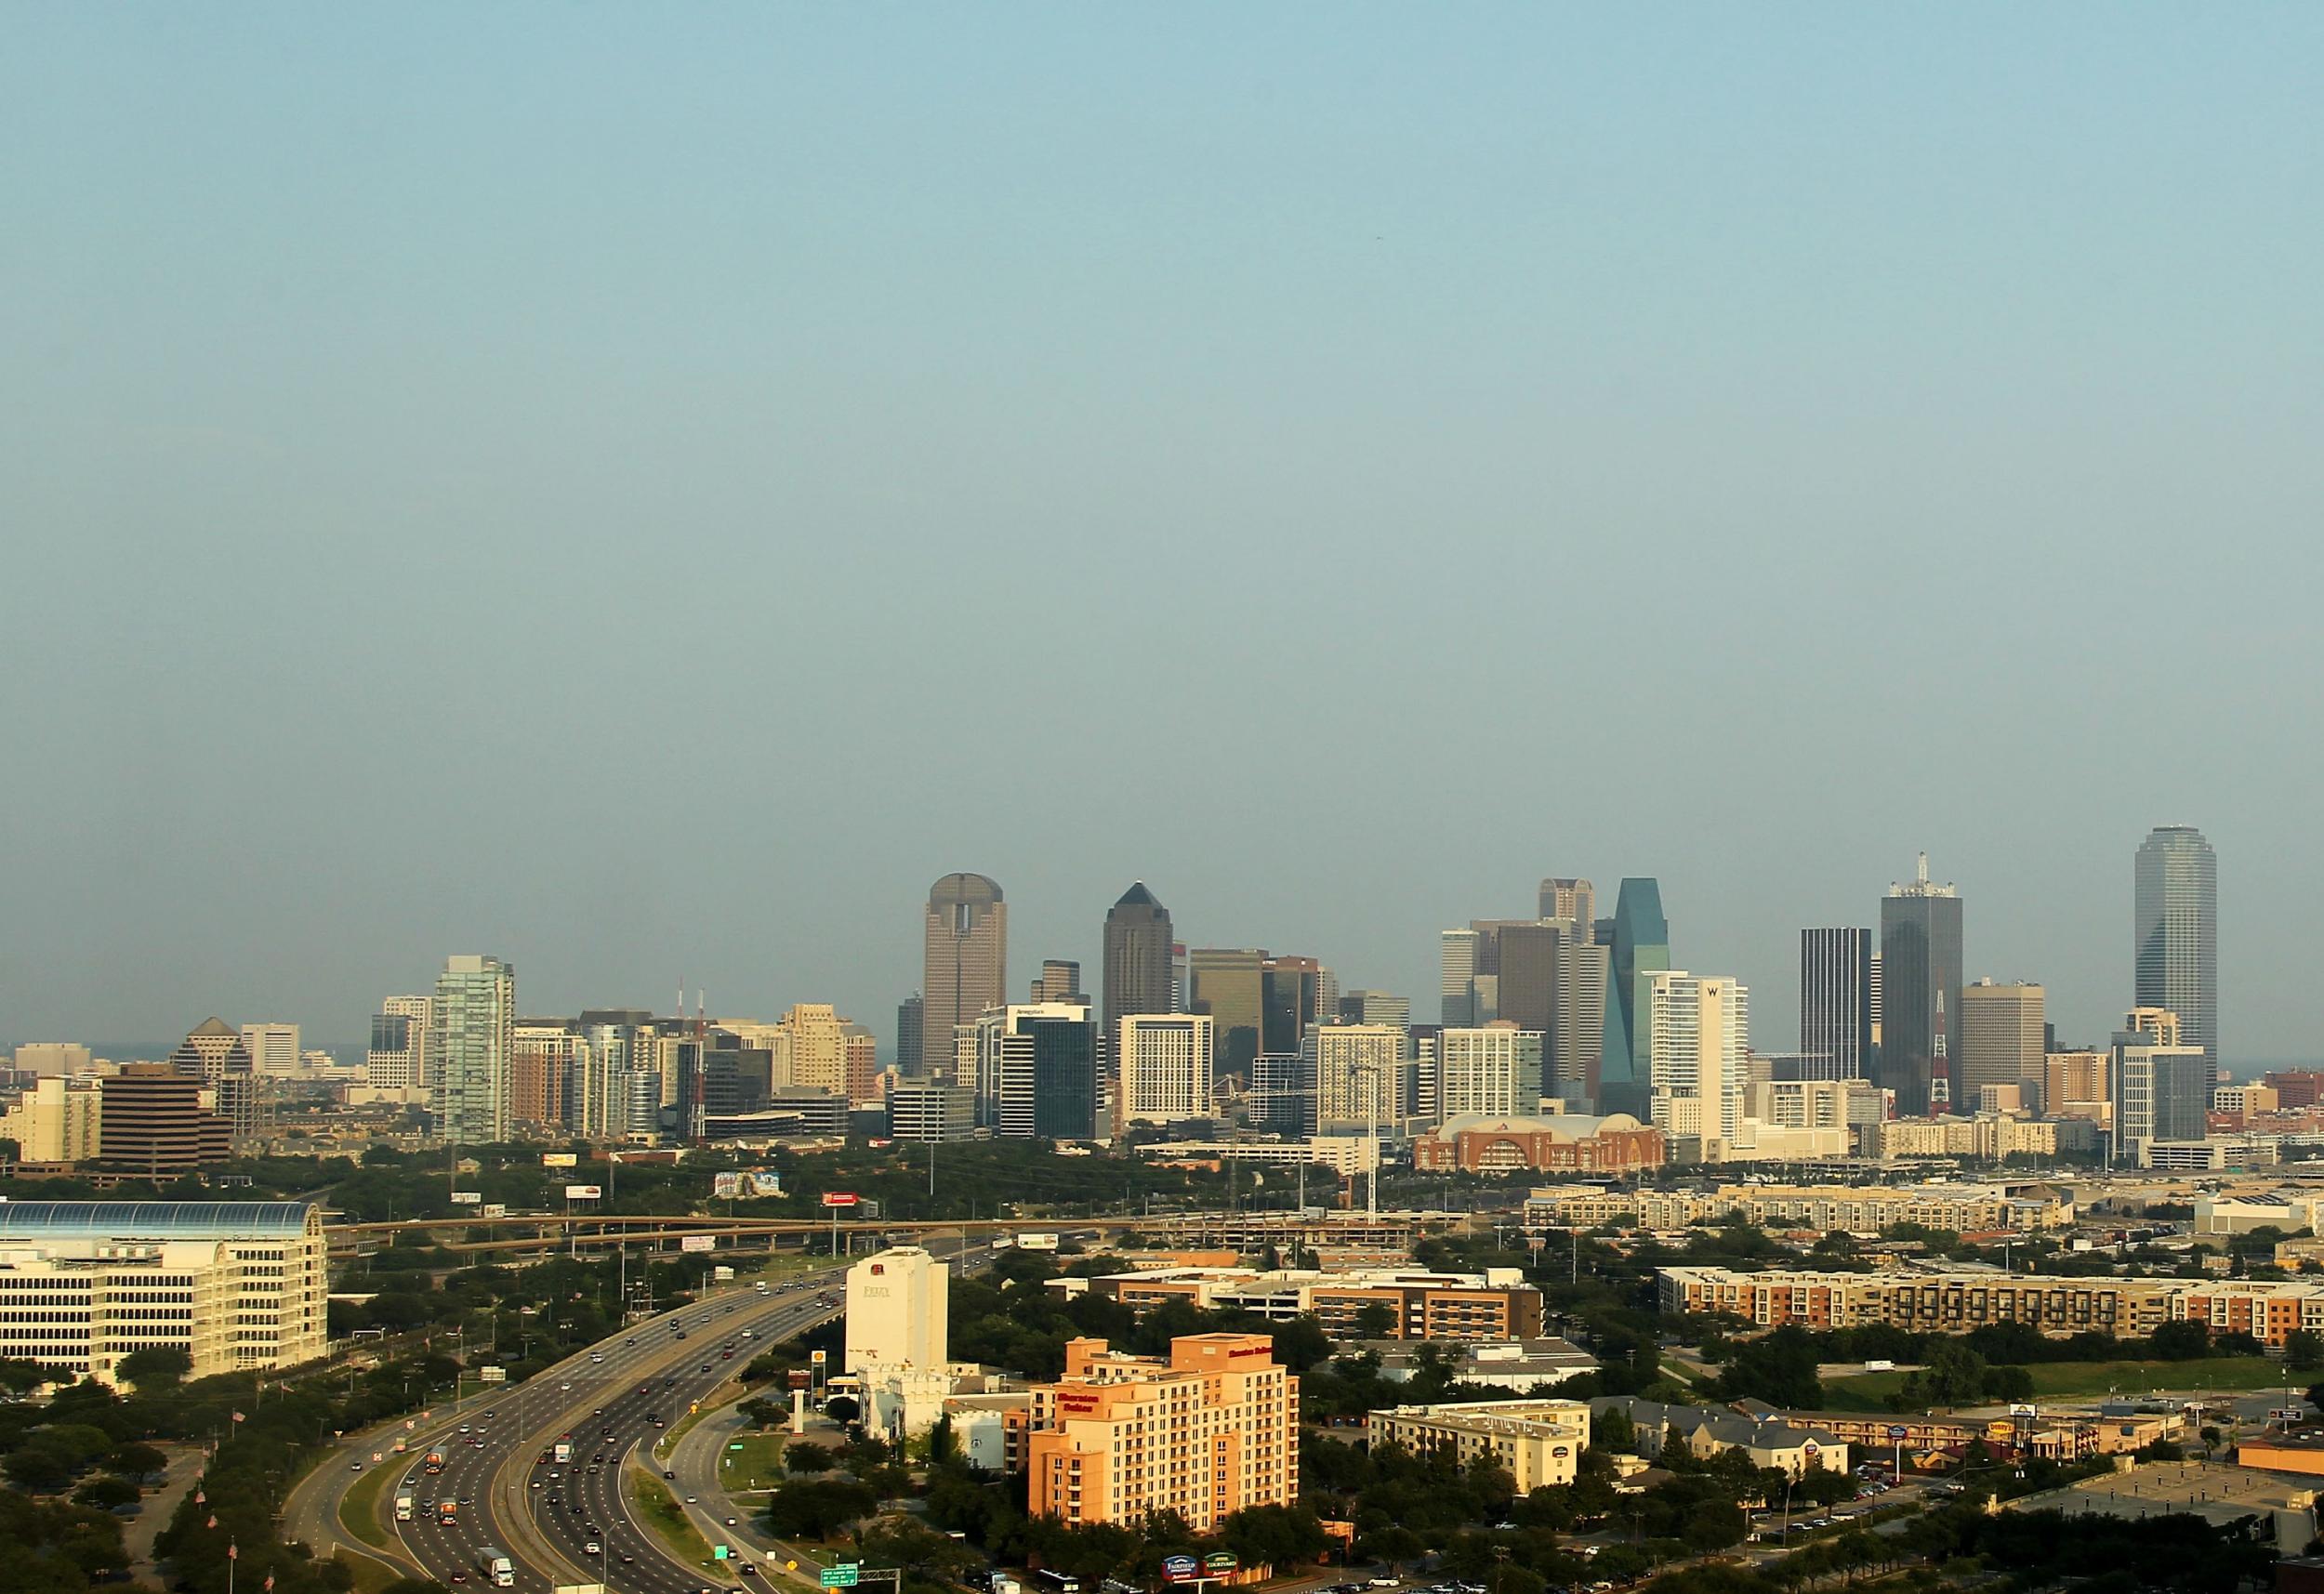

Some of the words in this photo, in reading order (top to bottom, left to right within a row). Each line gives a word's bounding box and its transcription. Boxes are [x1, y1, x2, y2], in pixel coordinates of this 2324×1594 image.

[1707, 987, 1718, 997] W
[1058, 1393, 1099, 1403] Sheraton
[1063, 1403, 1093, 1413] Suites
